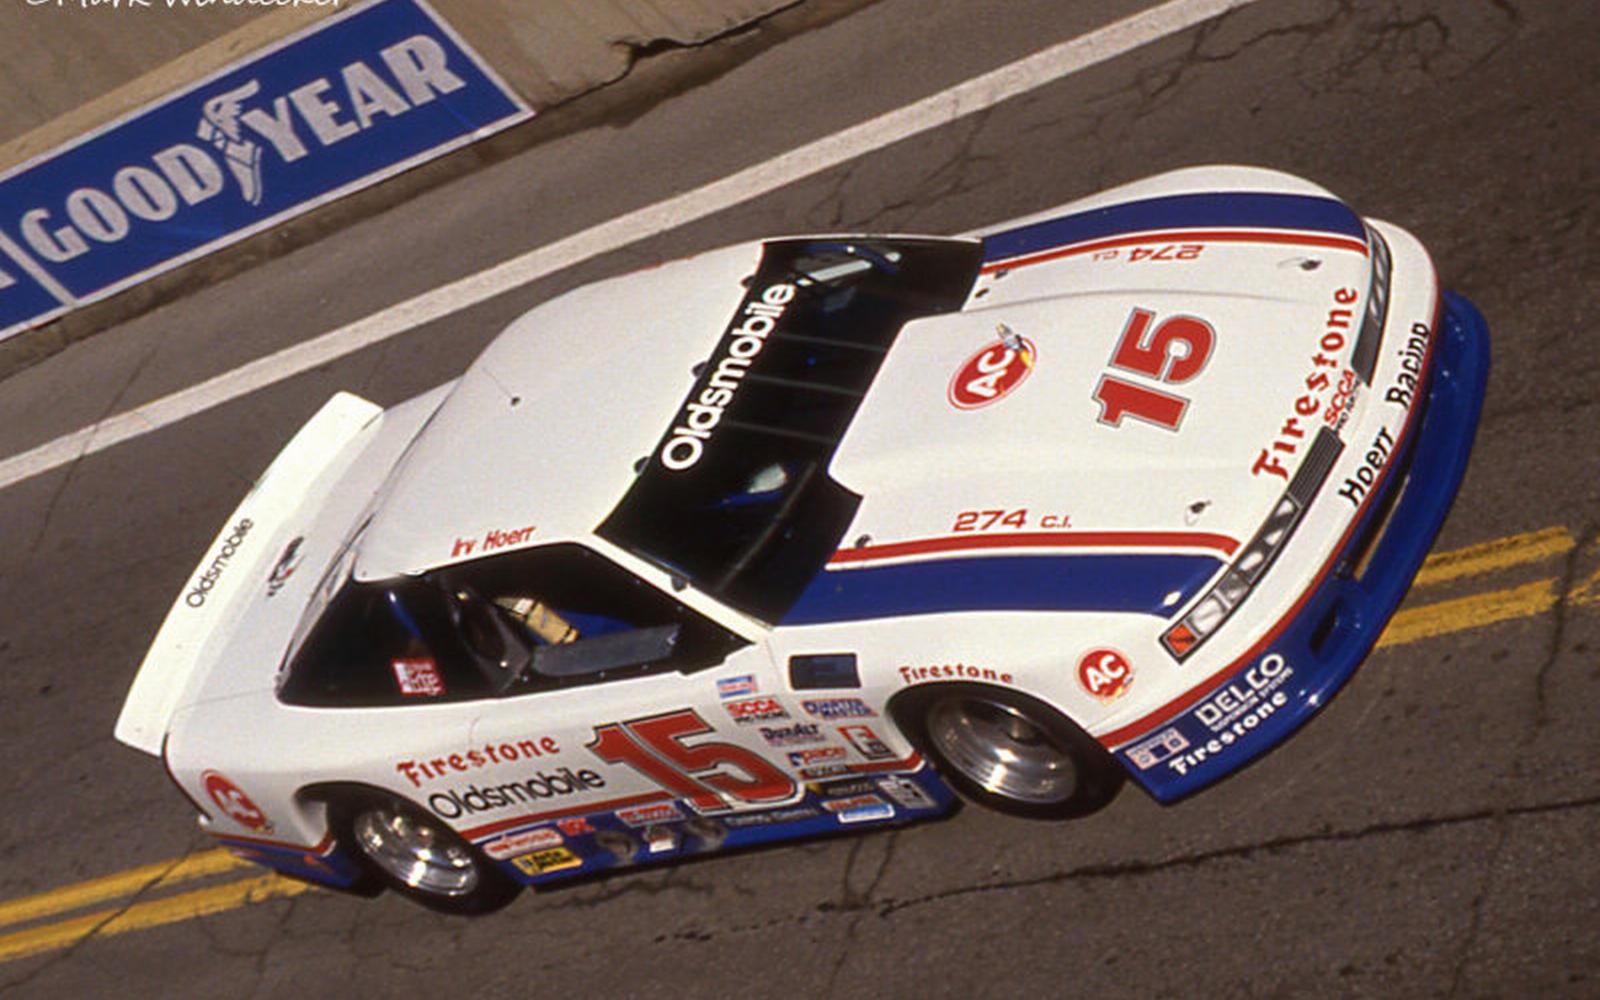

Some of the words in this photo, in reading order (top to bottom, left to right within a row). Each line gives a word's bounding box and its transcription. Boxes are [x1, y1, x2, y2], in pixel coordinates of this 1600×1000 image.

[20, 34, 467, 263] GOODYEAR
[1129, 244, 1204, 262] 274
[661, 284, 797, 470] Oldsmobile
[966, 349, 1015, 398] AC
[1092, 307, 1216, 432] 15
[1251, 287, 1358, 481] Firestone
[1323, 369, 1357, 427] SCCA
[1338, 426, 1394, 507] Hoerr
[482, 526, 537, 551] Hoerr
[953, 509, 1028, 532] 274
[186, 518, 254, 608] Oldsmobile
[899, 663, 1014, 685] Firestone
[1085, 654, 1125, 692] AC
[1195, 653, 1285, 726] DELCO
[397, 736, 561, 788] Firestone
[584, 707, 798, 811] 15
[1169, 691, 1288, 776] Firestone
[429, 767, 606, 819] Oldsmobile
